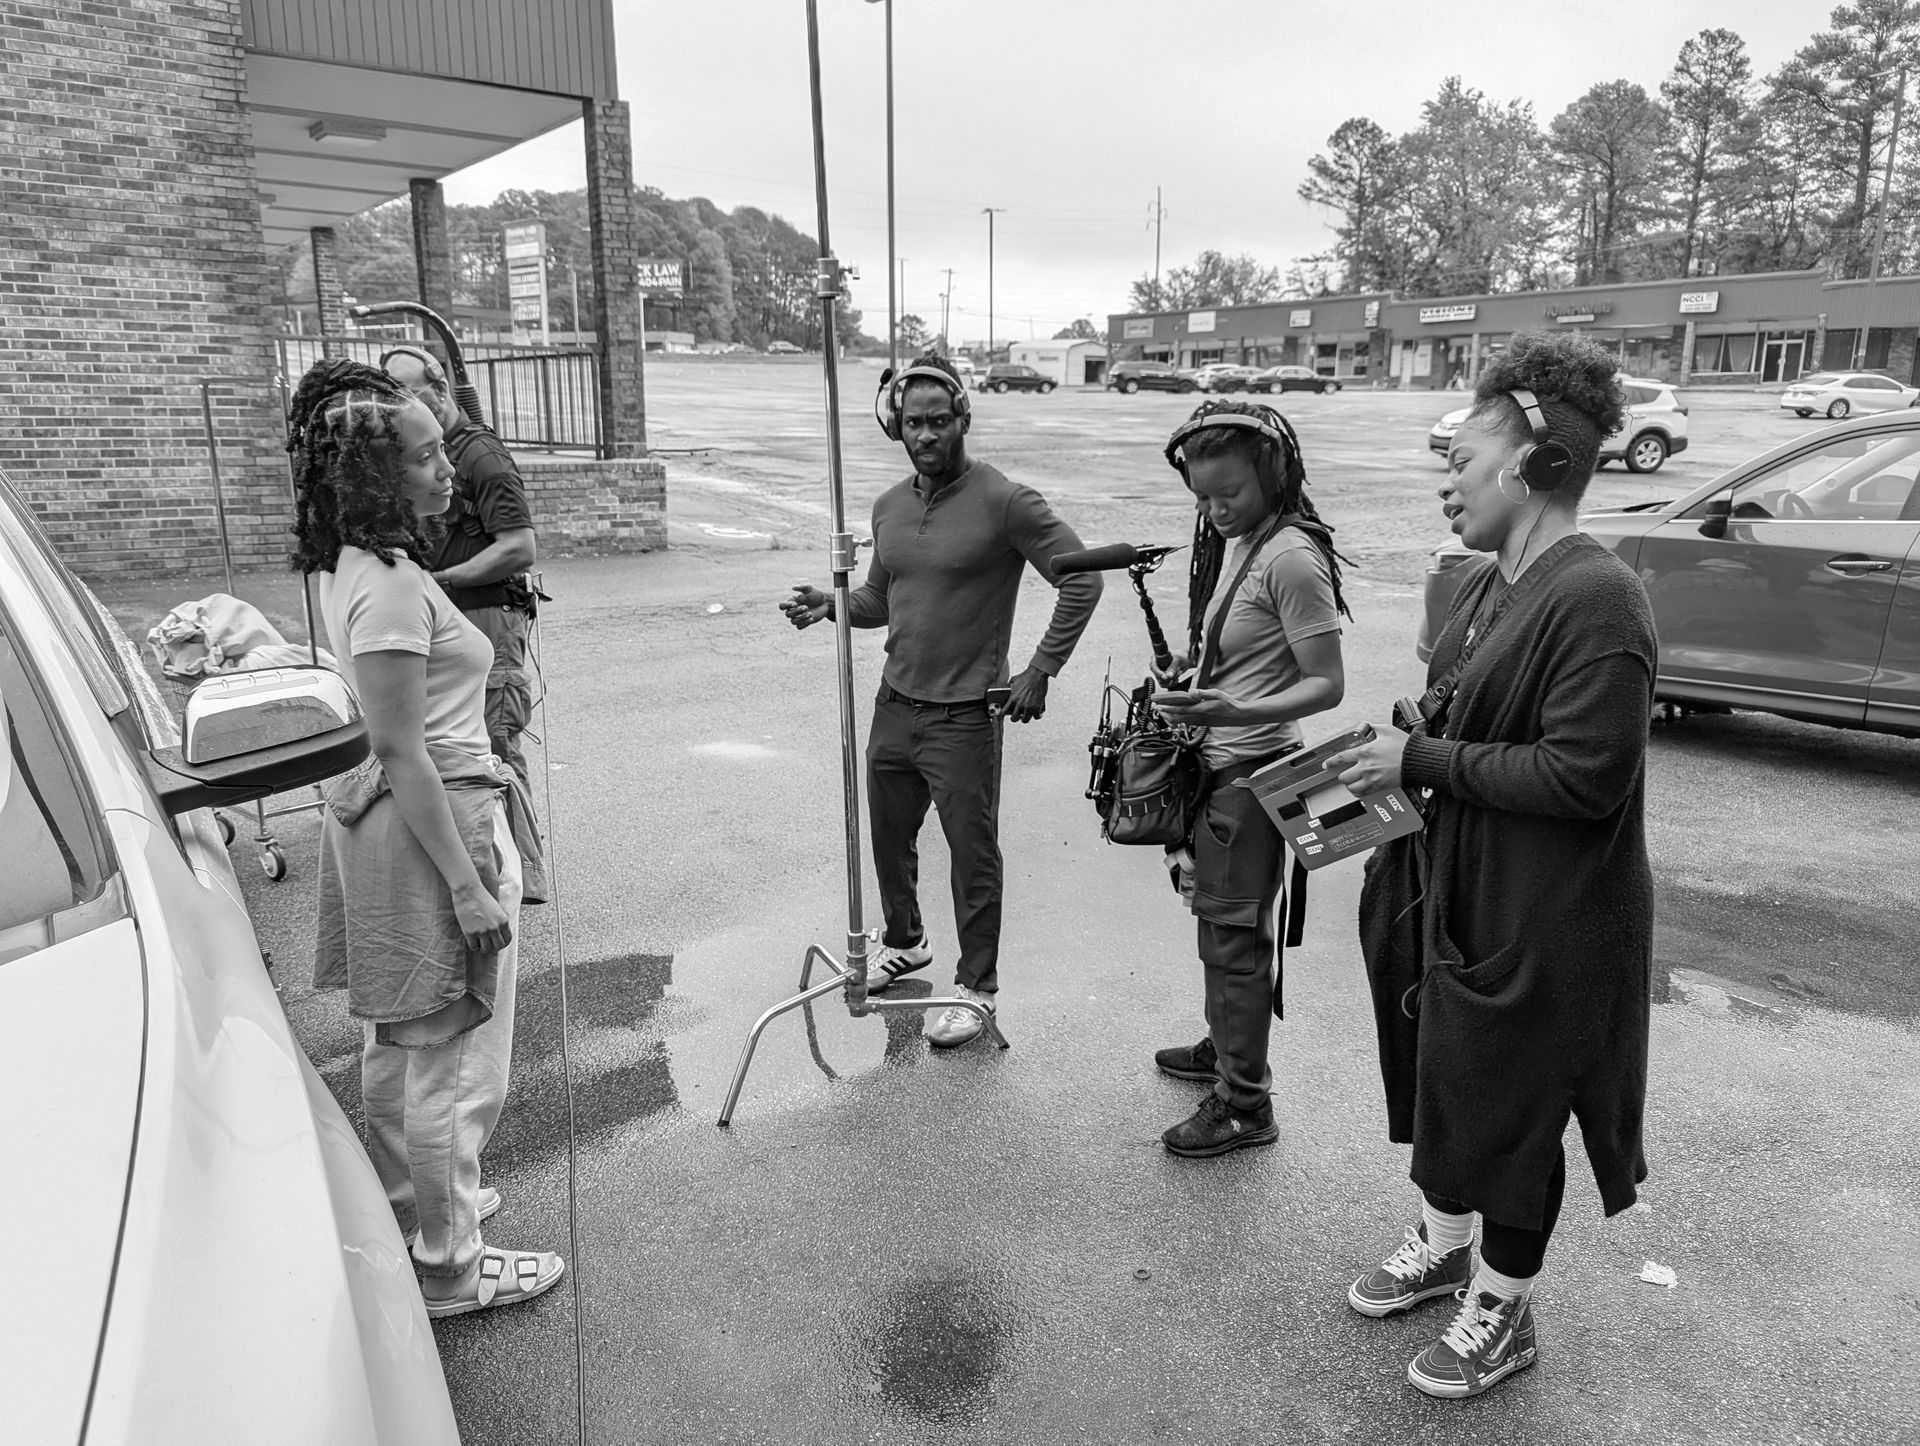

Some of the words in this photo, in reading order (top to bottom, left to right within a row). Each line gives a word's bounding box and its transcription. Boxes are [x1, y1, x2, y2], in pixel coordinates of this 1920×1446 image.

[653, 263, 680, 277] LAW
[1682, 295, 1704, 303] NCCI
[1550, 459, 1568, 467] SONY
